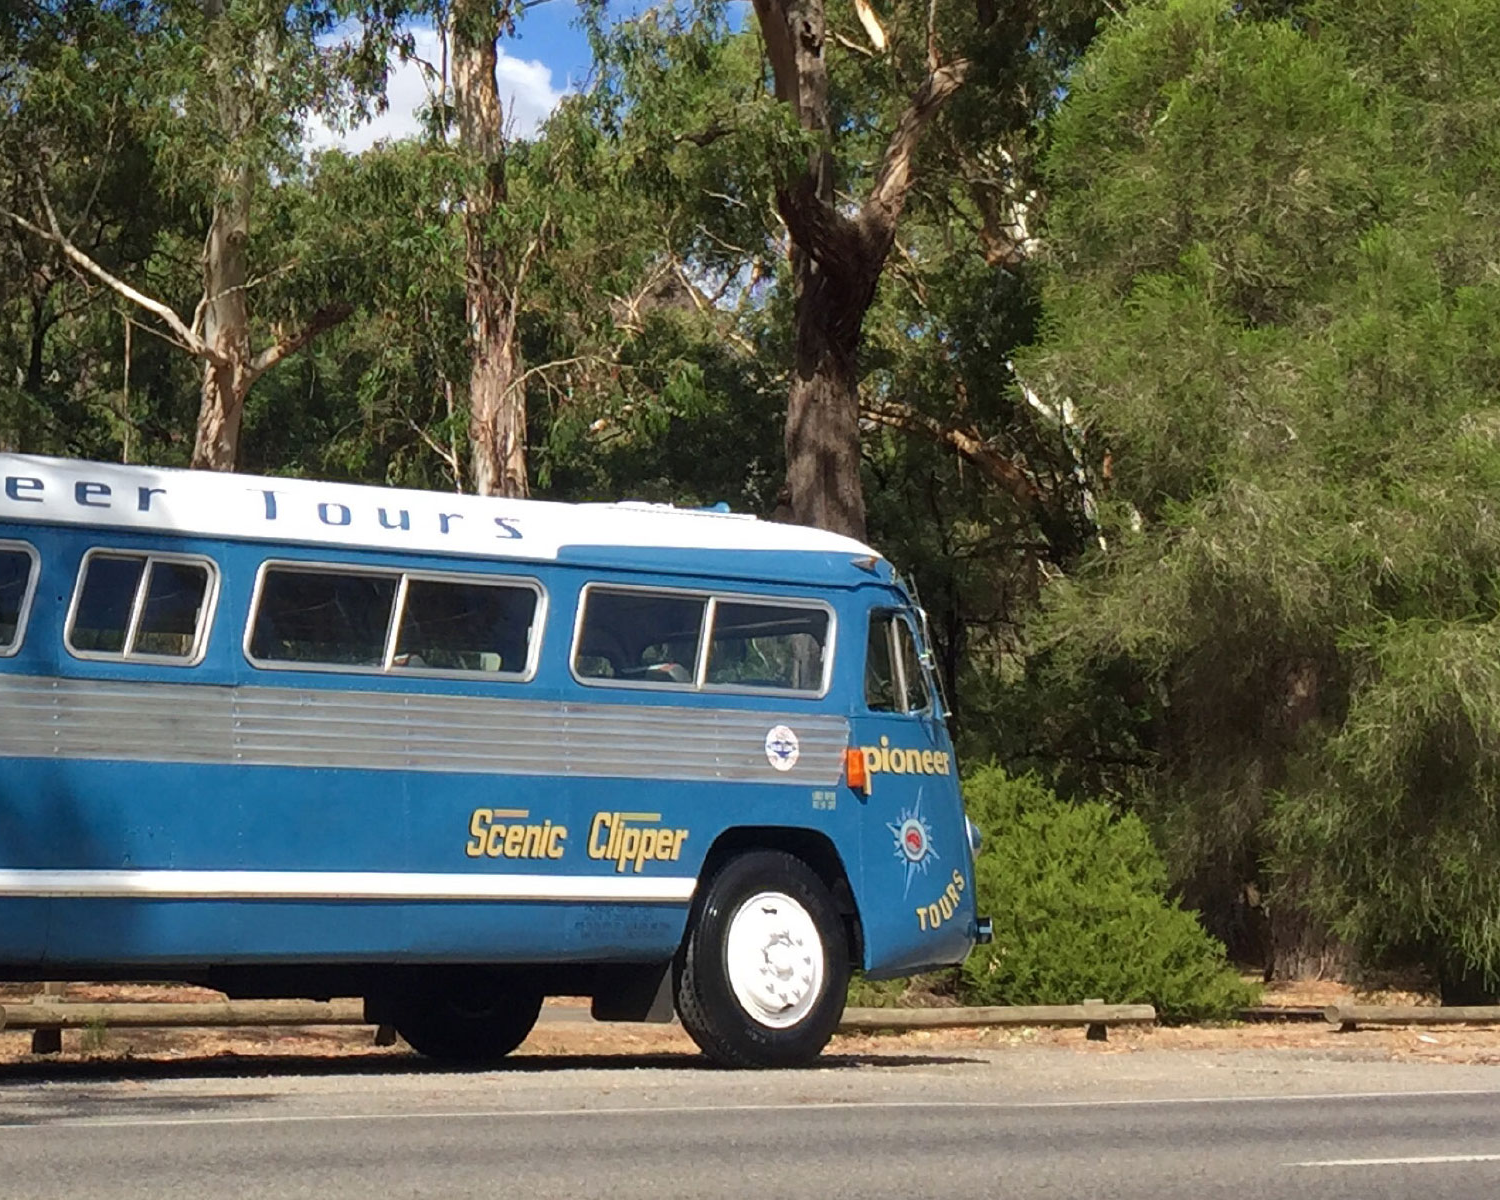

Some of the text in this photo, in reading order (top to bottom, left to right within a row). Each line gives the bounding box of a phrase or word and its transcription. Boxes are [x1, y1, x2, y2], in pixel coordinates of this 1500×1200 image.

[245, 488, 524, 540] Tours
[860, 735, 951, 796] pioneer
[466, 808, 690, 874] Scenic Clipper
[915, 868, 965, 931] TOURS
